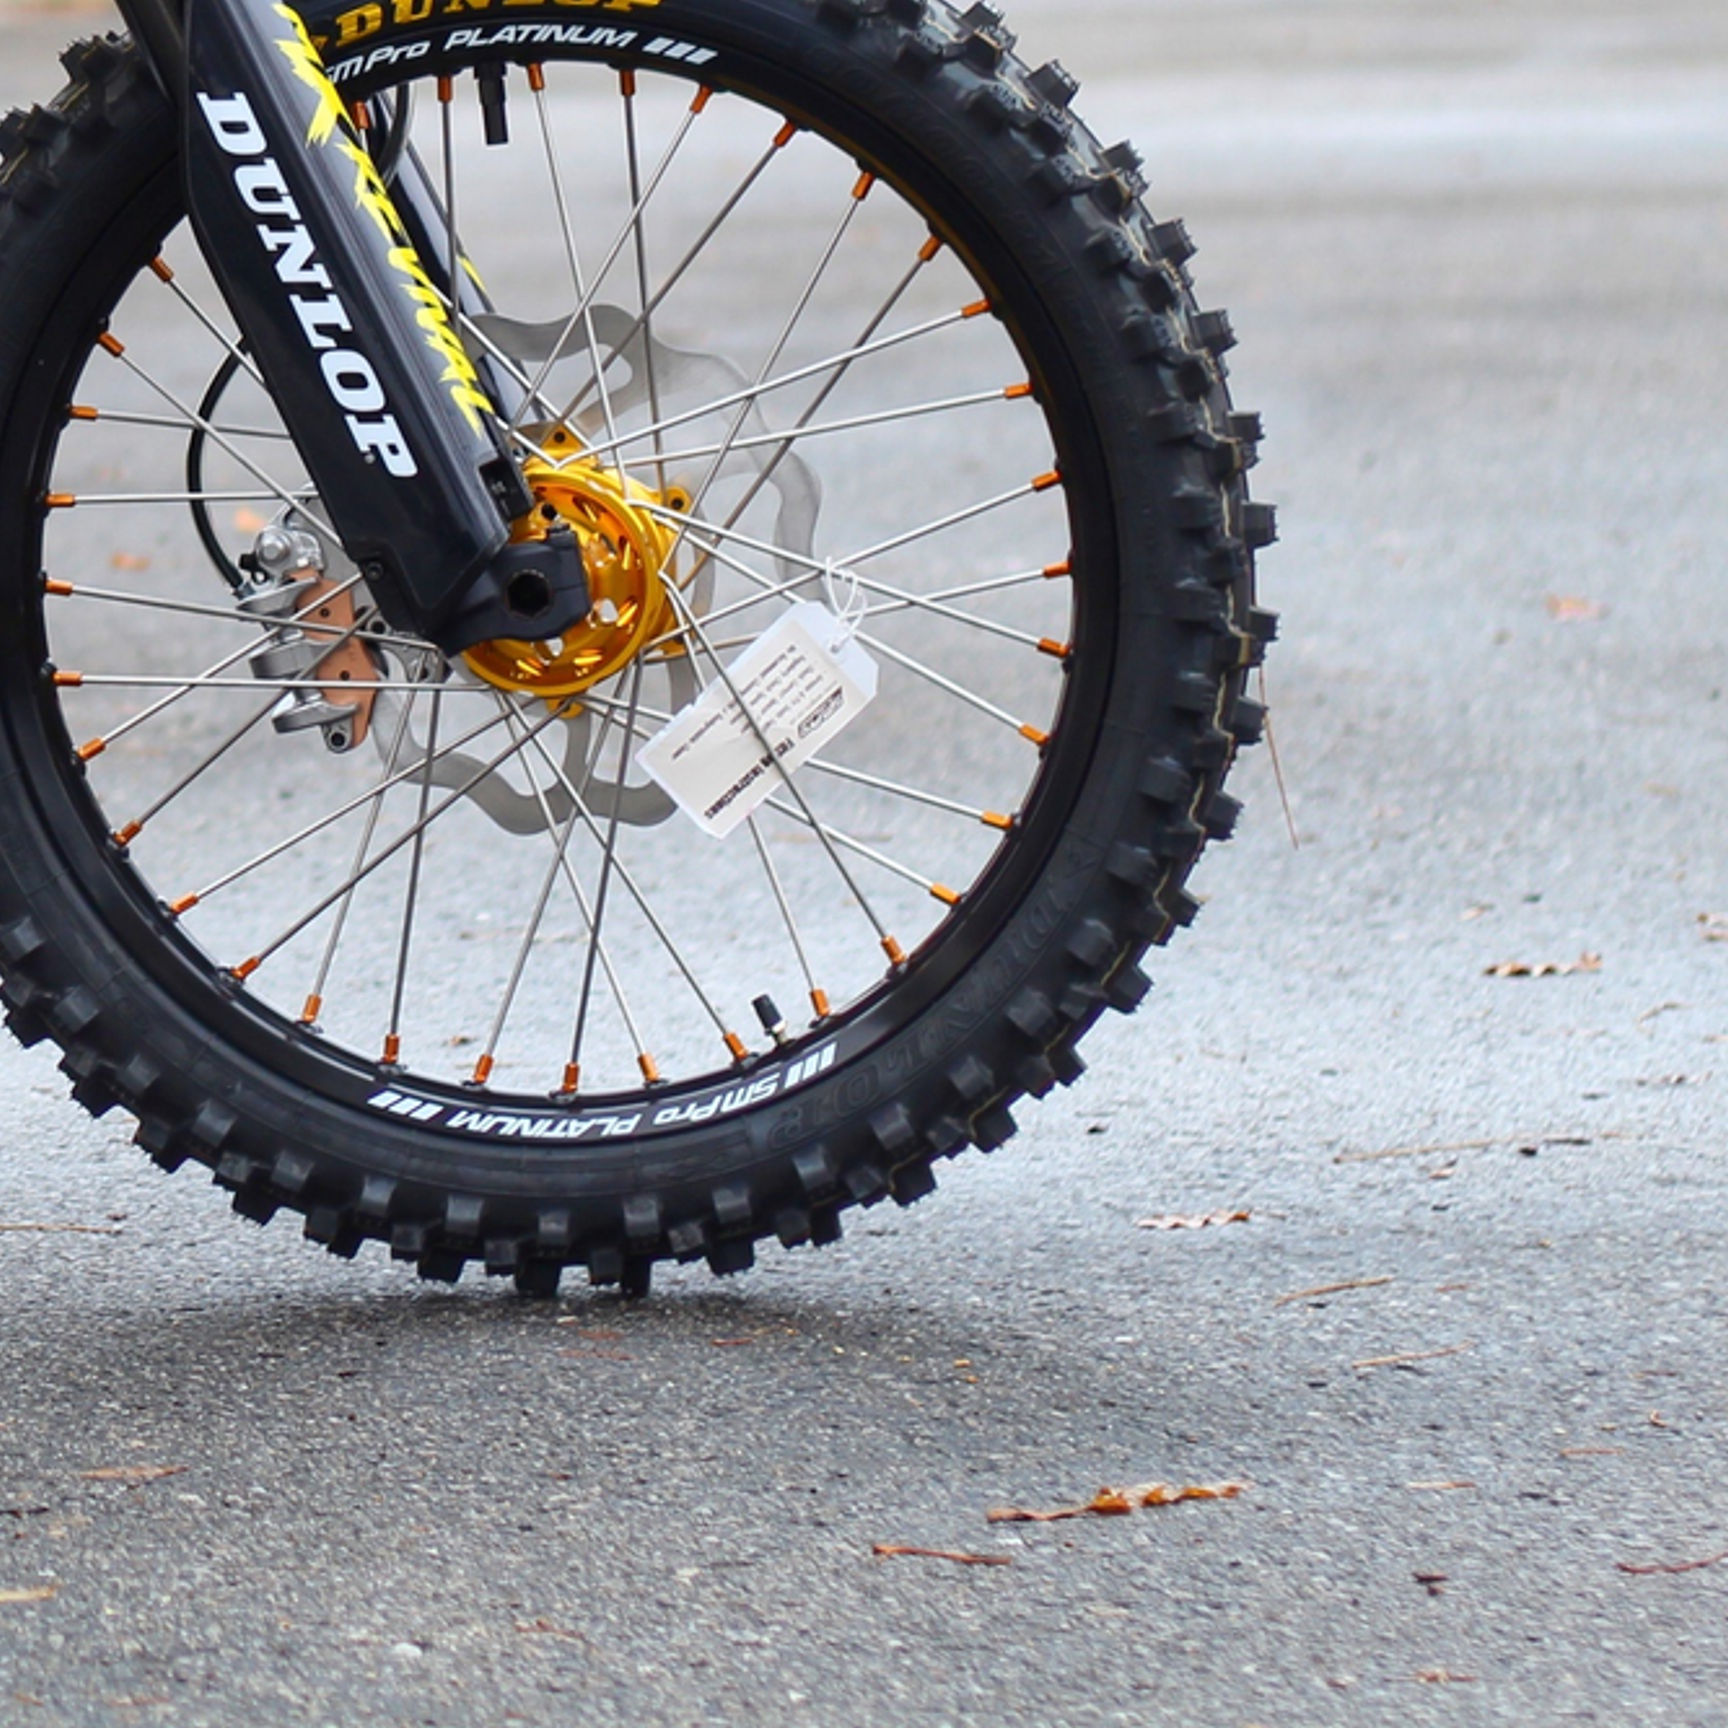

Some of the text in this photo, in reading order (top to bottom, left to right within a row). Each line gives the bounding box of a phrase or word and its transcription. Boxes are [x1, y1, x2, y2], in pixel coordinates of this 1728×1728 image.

[443, 23, 638, 51] PLATINUM
[196, 91, 419, 479] DUNLOP
[446, 1108, 643, 1139] PLATINUM
